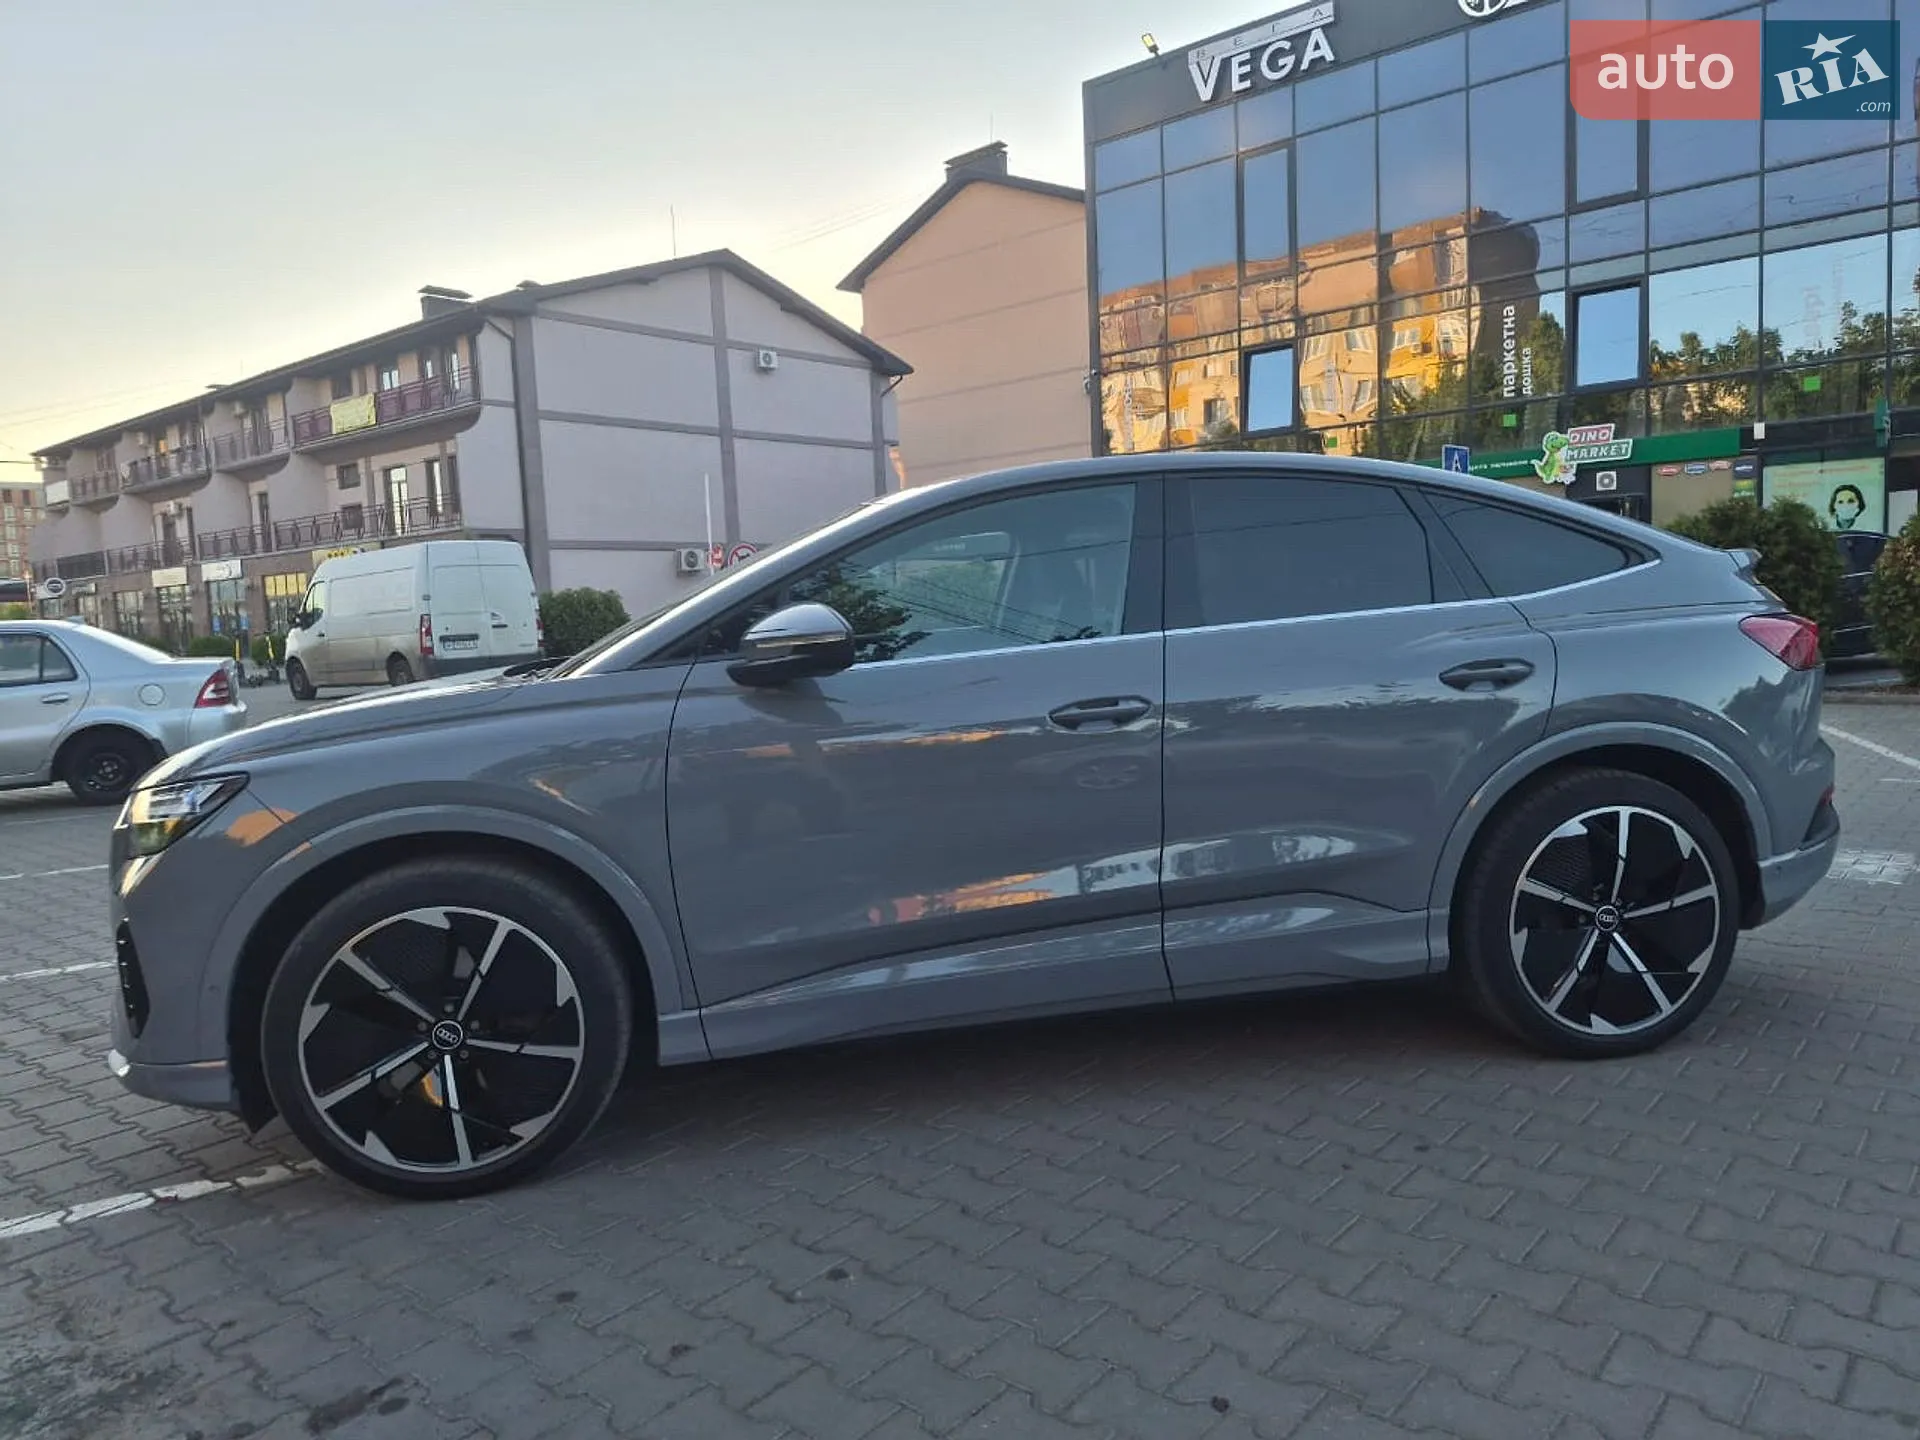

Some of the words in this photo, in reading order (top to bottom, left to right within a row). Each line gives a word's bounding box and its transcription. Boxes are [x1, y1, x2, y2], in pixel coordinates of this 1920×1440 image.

[1188, 27, 1335, 101] VEGA
[1503, 305, 1518, 397] паркетна
[1522, 347, 1533, 396] дошка
[1566, 443, 1629, 460] MARKET
[1570, 429, 1610, 444] DINO
